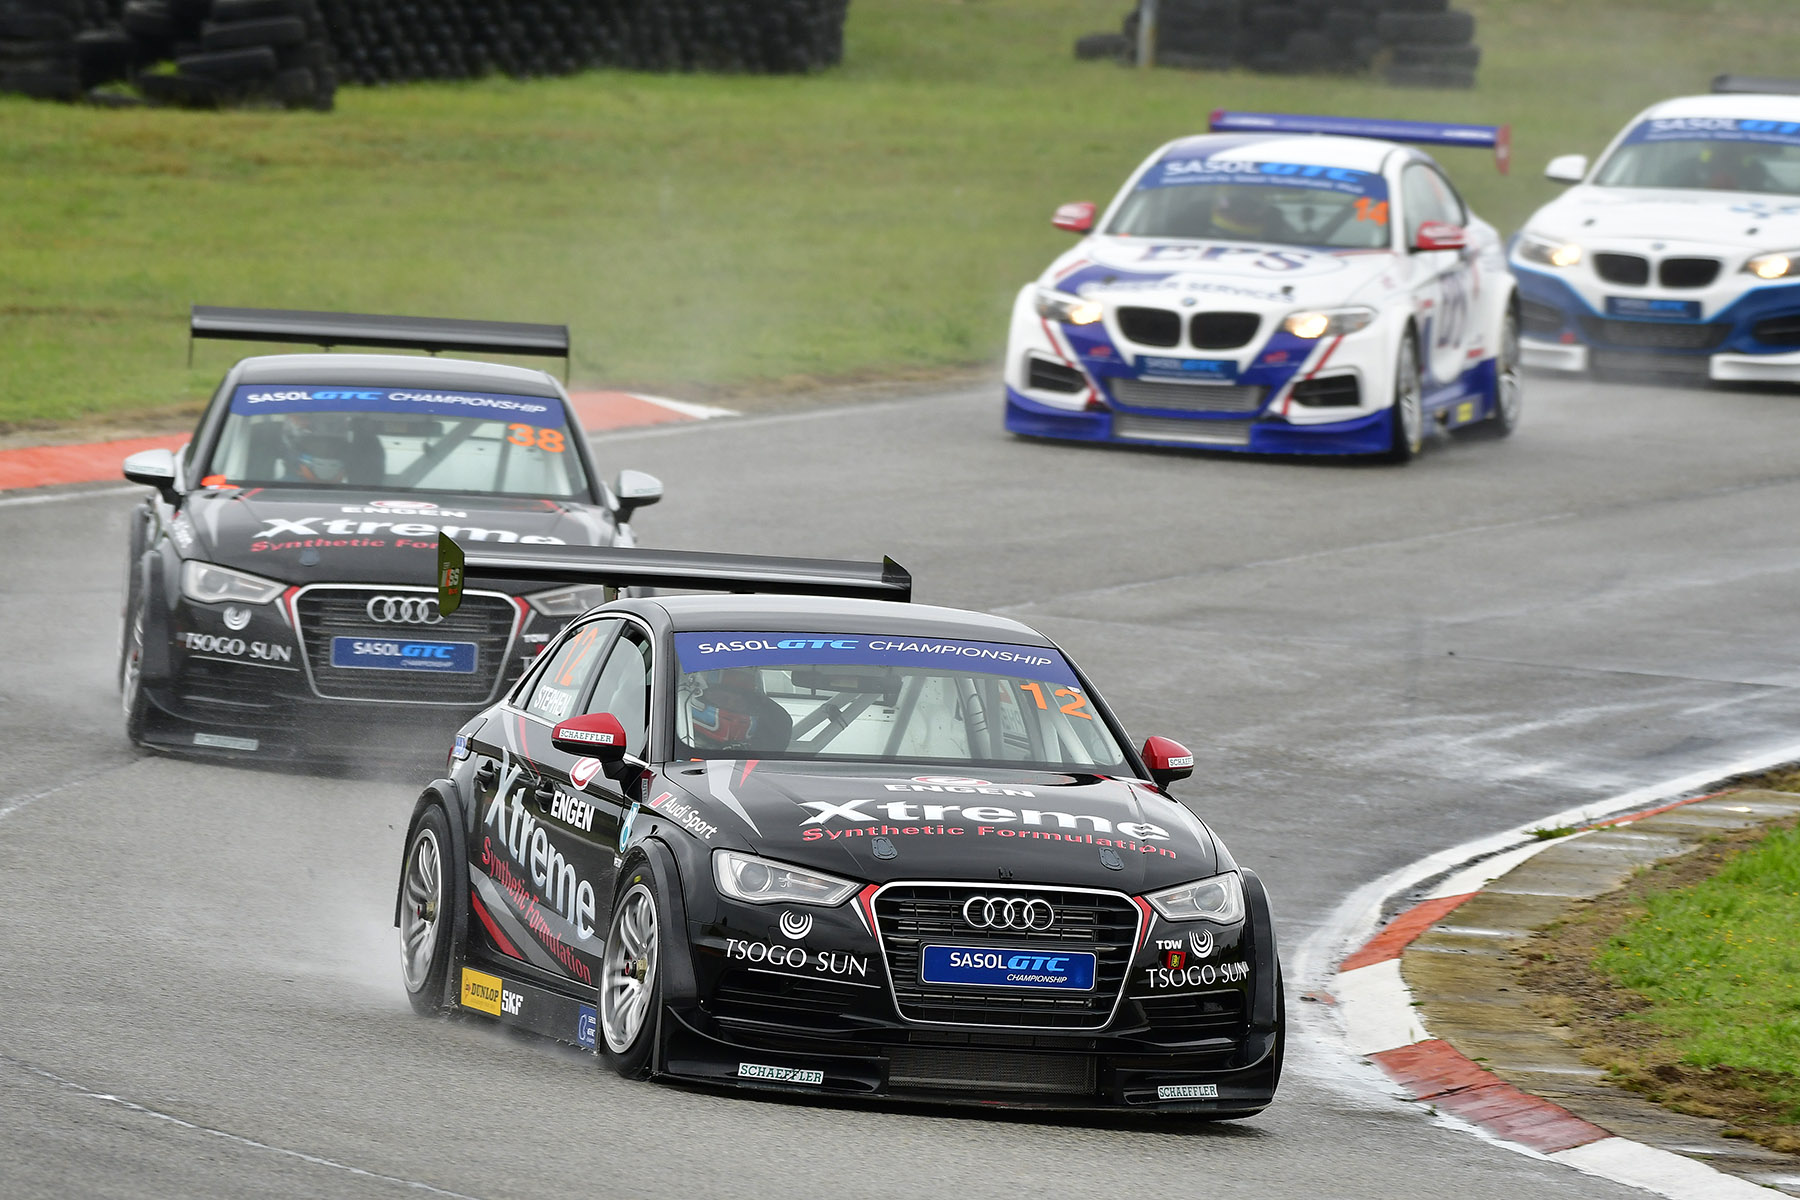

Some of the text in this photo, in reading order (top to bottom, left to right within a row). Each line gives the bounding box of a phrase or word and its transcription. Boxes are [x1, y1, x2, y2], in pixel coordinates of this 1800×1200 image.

[1353, 196, 1389, 226] 14
[388, 392, 548, 414] CHAMPIONSHIP
[506, 423, 566, 453] 38
[341, 506, 468, 519] ENGEN
[251, 537, 386, 552] Synthetic
[184, 632, 293, 663] TSOGO SUN
[553, 624, 599, 688] 12
[867, 640, 1053, 667] CHAMPIONSHIP
[533, 684, 573, 718] STEPHEN
[1019, 682, 1093, 720] 12
[560, 729, 612, 743] SCHAEFFLER
[884, 784, 1037, 799] ENGEN
[550, 789, 596, 832] ENGEN
[661, 797, 718, 840] Audi Sport
[797, 798, 1171, 842] Xtreme
[484, 745, 597, 940] Xtreme
[801, 824, 1178, 860] Synthetic Formulation
[481, 836, 592, 986] Synthetic Formulation
[726, 938, 868, 977] TSOGO SUN
[1156, 939, 1183, 950] TOW
[1006, 973, 1068, 983] CHAMPIONSHIP
[1145, 961, 1249, 988] TSOGO SUN
[471, 982, 500, 1002] DUNLOP
[501, 989, 524, 1016] SKF
[740, 1064, 822, 1083] SCHAEFFLER
[1158, 1085, 1217, 1097] SCHAEFFLER
